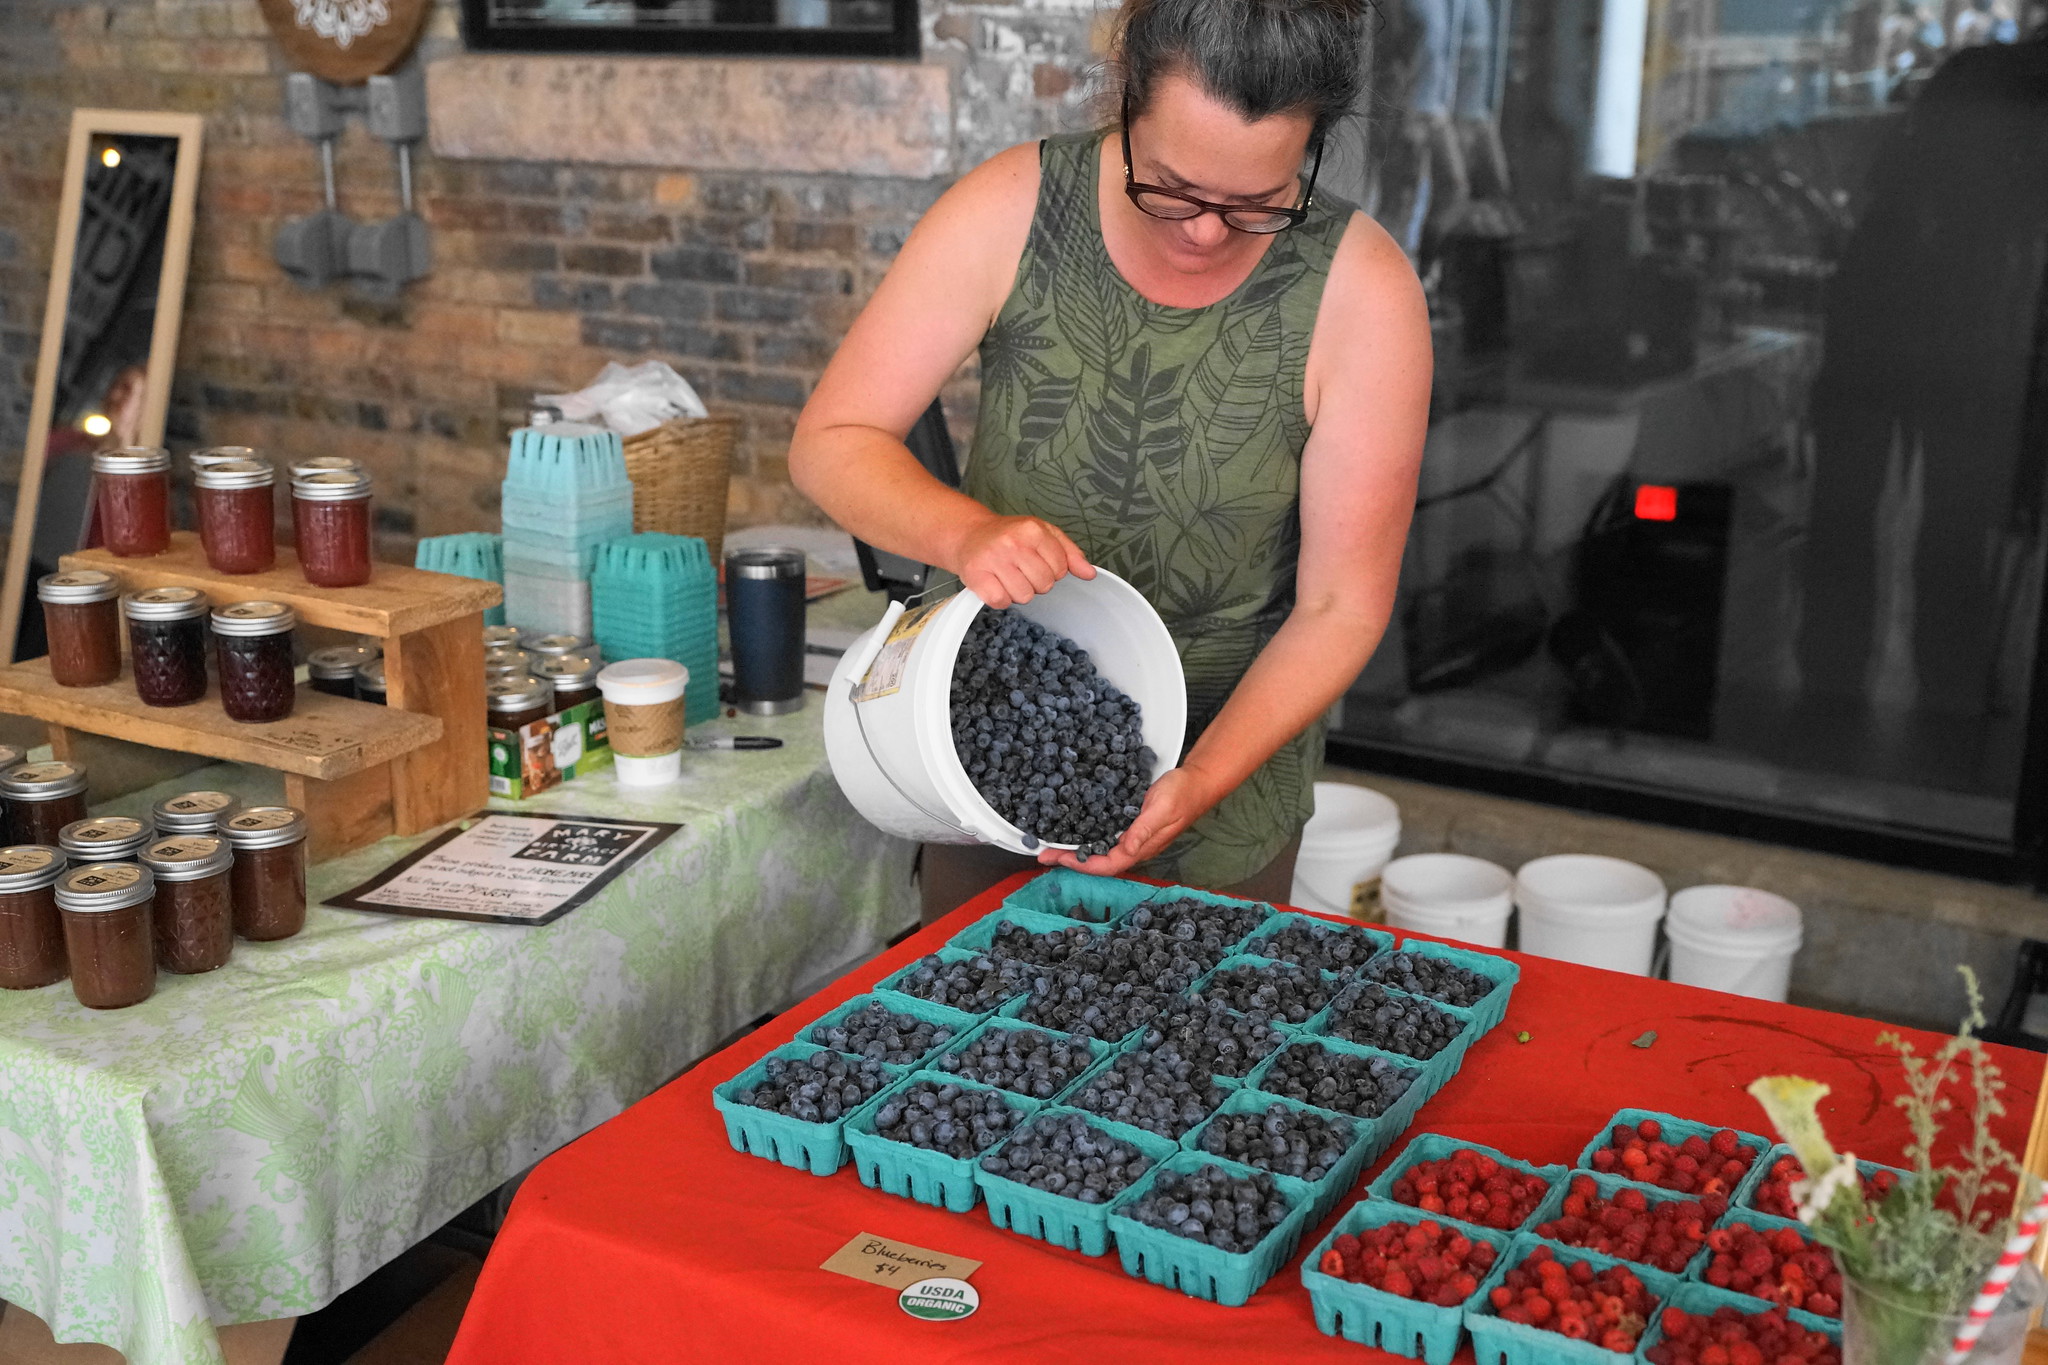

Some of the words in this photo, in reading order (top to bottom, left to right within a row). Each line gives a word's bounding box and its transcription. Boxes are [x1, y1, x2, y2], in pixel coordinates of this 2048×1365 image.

[552, 828, 632, 841] MARY
[522, 848, 602, 864] FARM
[861, 1239, 947, 1272] Blueberries
[874, 1262, 901, 1276] $4
[919, 1285, 966, 1300] USDA
[906, 1297, 967, 1314] ORGANIC
